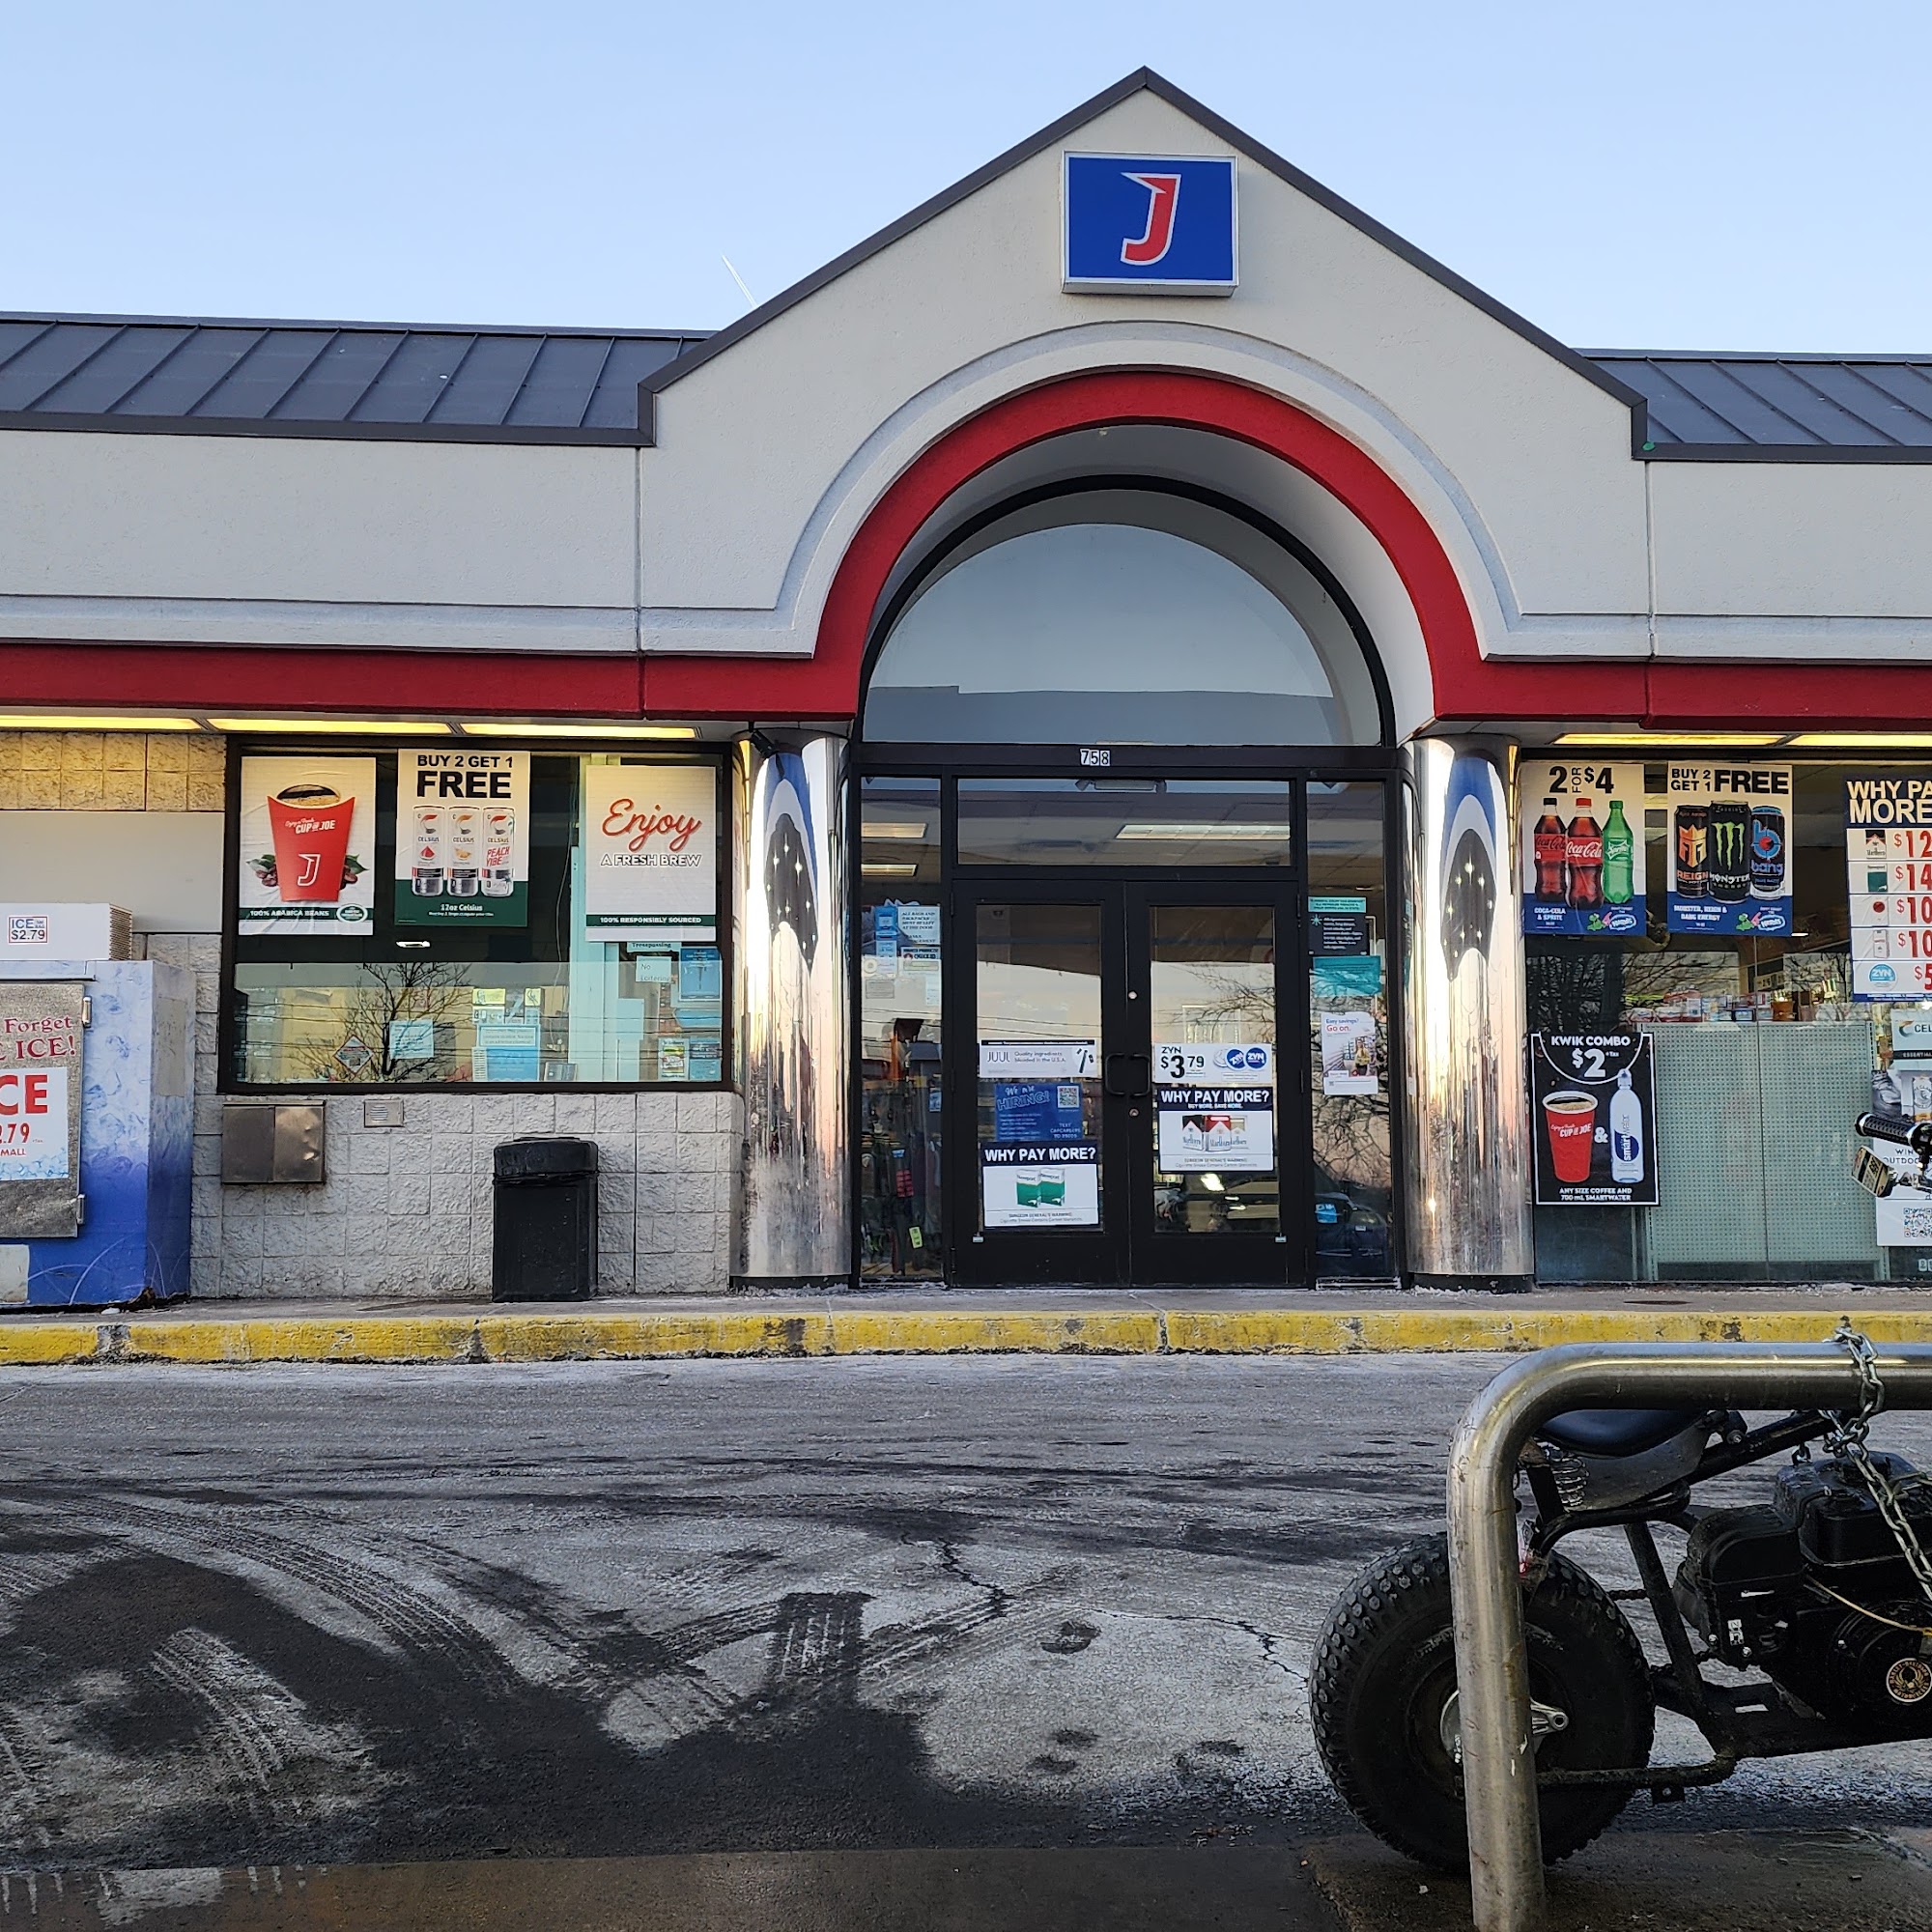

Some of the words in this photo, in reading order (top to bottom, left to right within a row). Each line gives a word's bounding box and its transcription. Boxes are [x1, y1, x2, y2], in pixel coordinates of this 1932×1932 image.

[1121, 172, 1181, 266] J
[417, 755, 450, 767] BUY
[454, 755, 465, 767] 2
[469, 756, 500, 768] GET
[505, 756, 513, 768] 1
[1081, 750, 1109, 765] 758
[1549, 766, 1567, 793] 2
[1571, 767, 1582, 793] FOR
[1584, 766, 1614, 794] $4
[1672, 769, 1698, 779] BUY
[1703, 770, 1711, 779] 2
[416, 770, 513, 799] FREE
[1671, 780, 1699, 791] GET
[1705, 781, 1711, 791] 1
[1715, 770, 1789, 794] FREE
[1847, 781, 1902, 799] WHY
[1849, 799, 1932, 824] MORE
[296, 823, 312, 834] CUP
[319, 820, 335, 831] JOE
[602, 798, 702, 853] Enjoy
[1894, 830, 1932, 858] $12
[487, 846, 510, 858] PEACH
[487, 856, 502, 867] VIBE
[601, 854, 612, 866] A
[614, 854, 657, 867] FRESH
[659, 854, 701, 867] BREW
[1751, 860, 1783, 875] bang
[1677, 870, 1708, 880] REIGN
[1709, 871, 1750, 884] MONSTER
[1895, 864, 1932, 891] $14
[1896, 896, 1932, 924] $10
[12, 919, 34, 928] ICE
[11, 929, 45, 940] $2.79
[1898, 929, 1932, 958] $10
[4, 1016, 72, 1033] Forget
[15, 1035, 76, 1059] ICE!
[1551, 1036, 1584, 1046] KWIK
[1586, 1036, 1631, 1046] COMBO
[988, 1051, 1010, 1063] JUUL
[1572, 1048, 1606, 1077] $2
[996, 1090, 1051, 1111] HIRING!
[1161, 1090, 1192, 1103] WHY
[1194, 1090, 1221, 1103] PAY
[1224, 1090, 1270, 1103] MORE?
[1560, 1129, 1573, 1137] CUP
[1579, 1123, 1591, 1135] JOE
[1594, 1127, 1608, 1143] &
[984, 1149, 1016, 1162] WHY
[1019, 1148, 1047, 1161] PAY
[1049, 1147, 1096, 1161] MORE?
